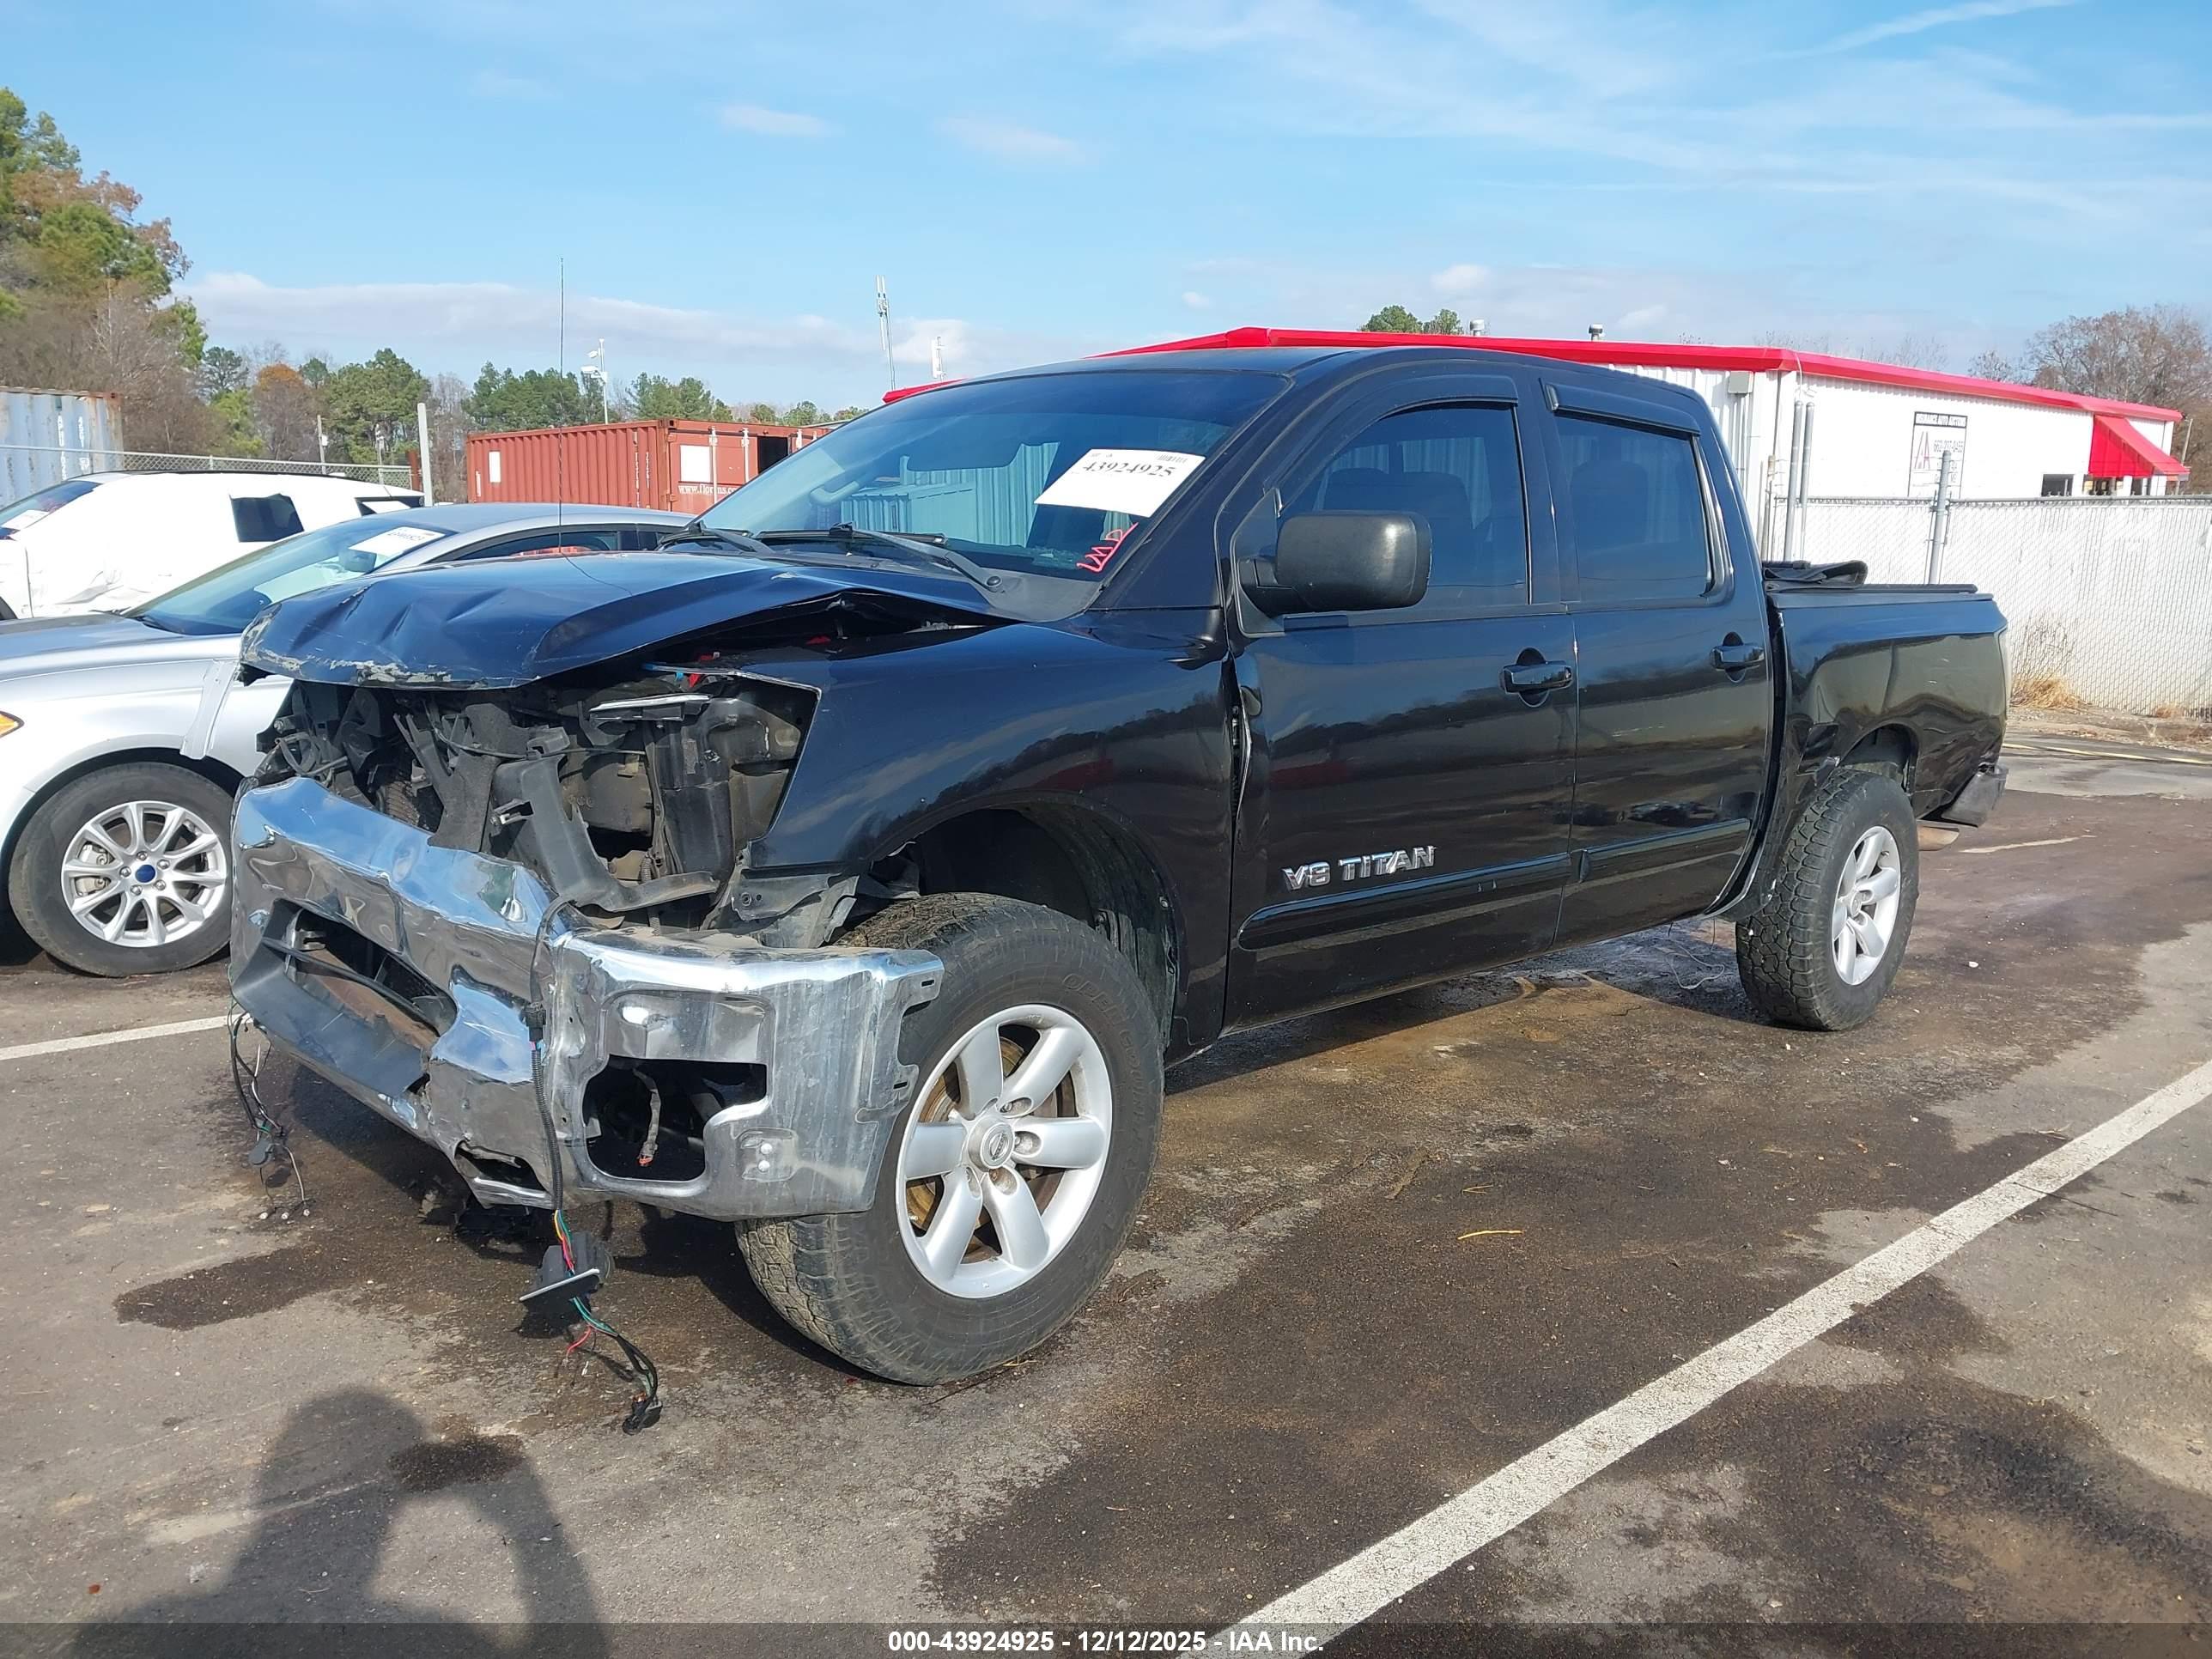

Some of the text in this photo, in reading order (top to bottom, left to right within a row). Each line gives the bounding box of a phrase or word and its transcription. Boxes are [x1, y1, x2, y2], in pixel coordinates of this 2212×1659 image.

[1082, 460, 1177, 477] 43924925
[1281, 845, 1437, 890] V8 TITAN
